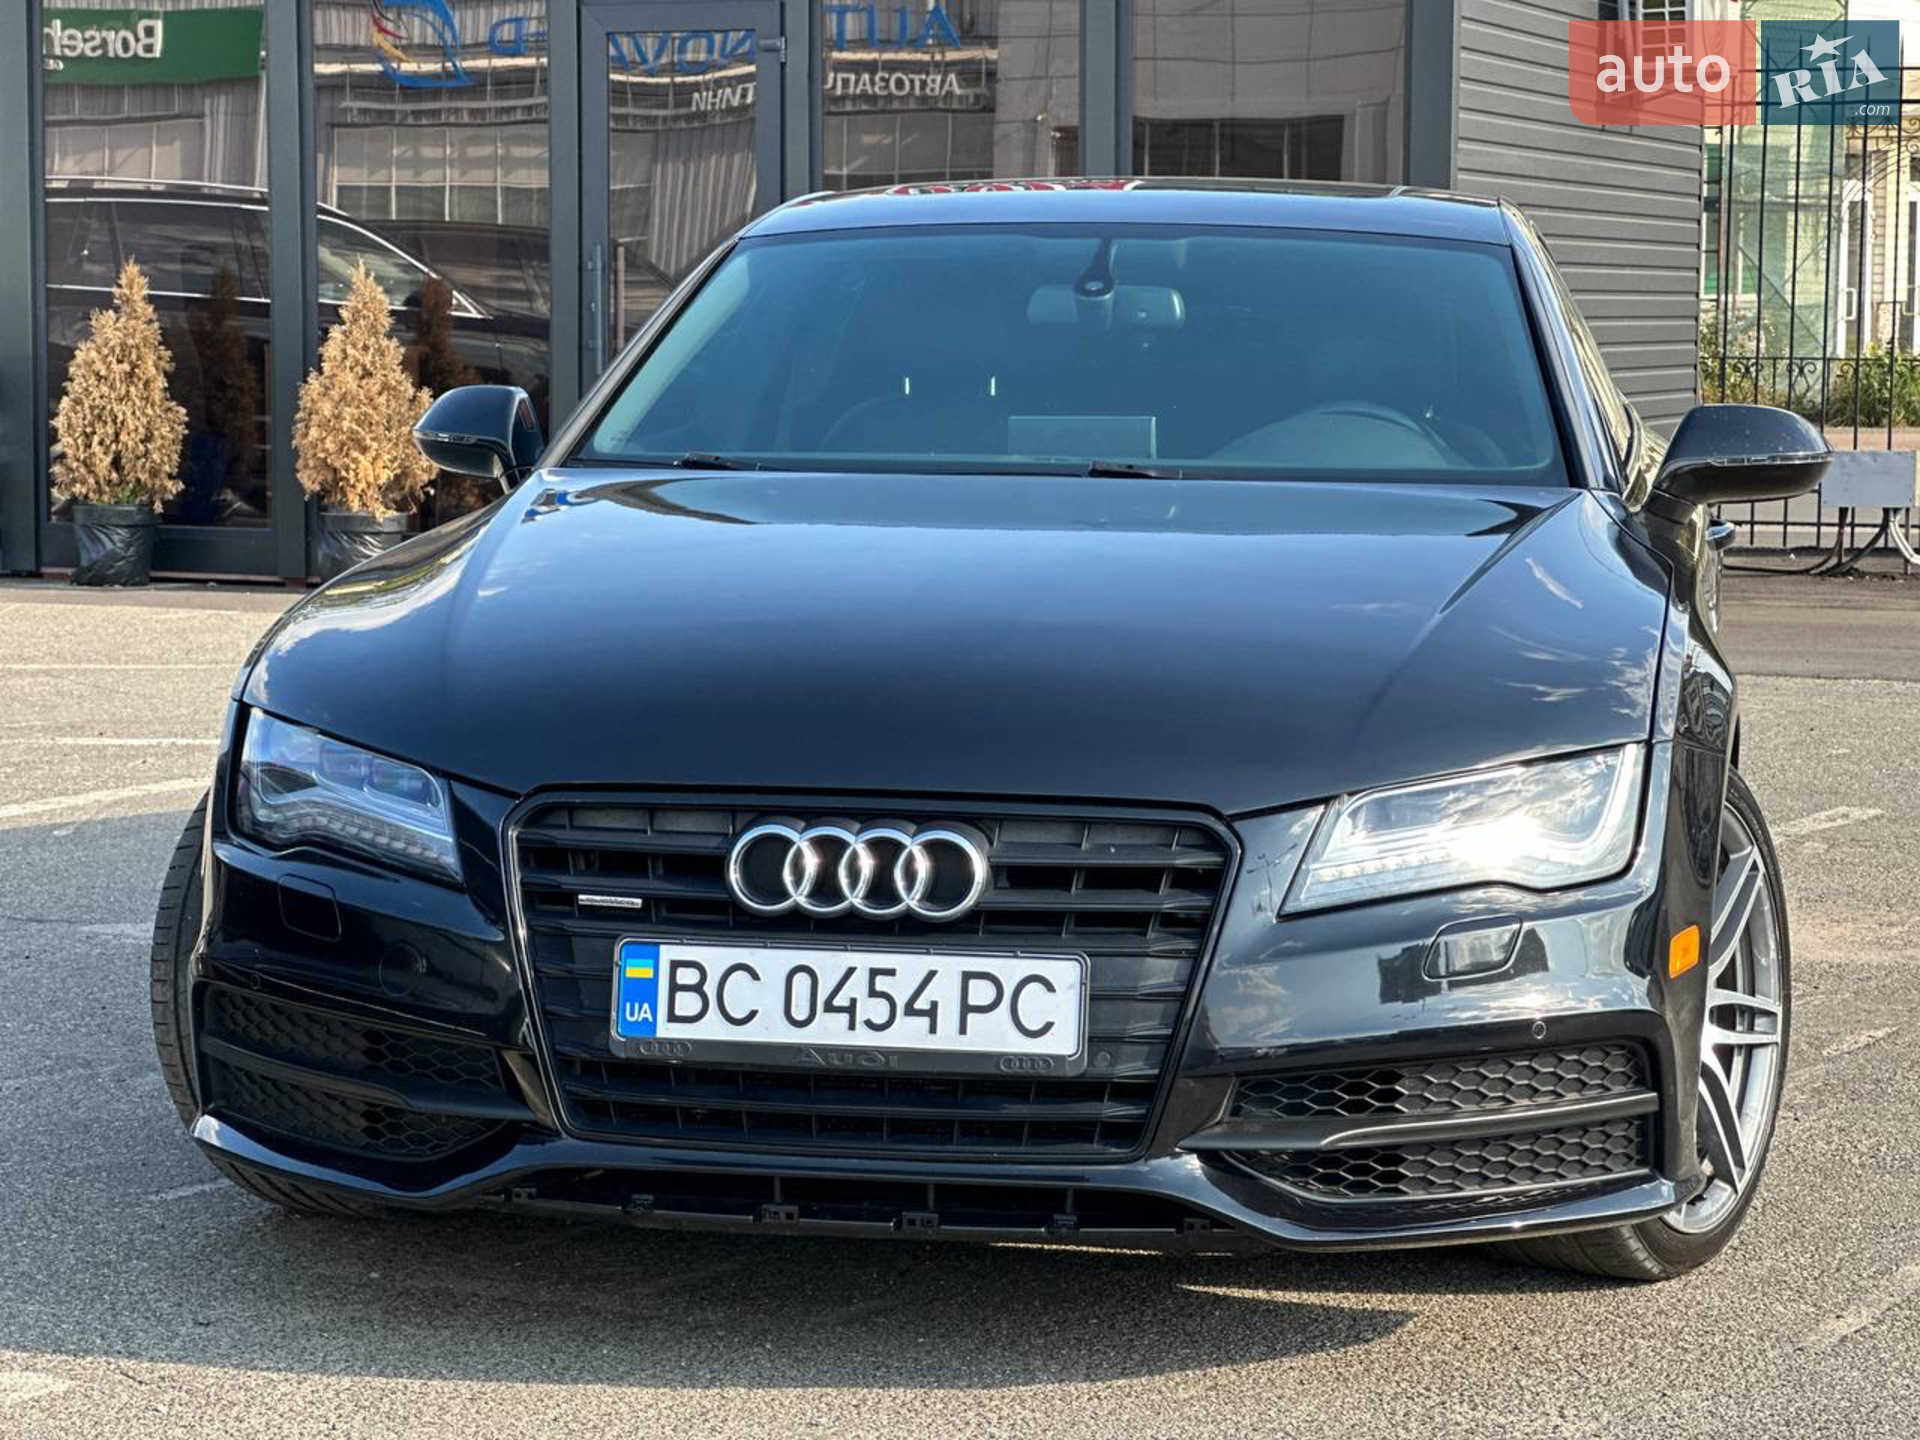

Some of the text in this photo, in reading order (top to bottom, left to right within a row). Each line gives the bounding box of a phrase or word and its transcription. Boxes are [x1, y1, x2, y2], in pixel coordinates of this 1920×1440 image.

[625, 1001, 653, 1023] UA
[666, 958, 1057, 1040] BC 0454 PC
